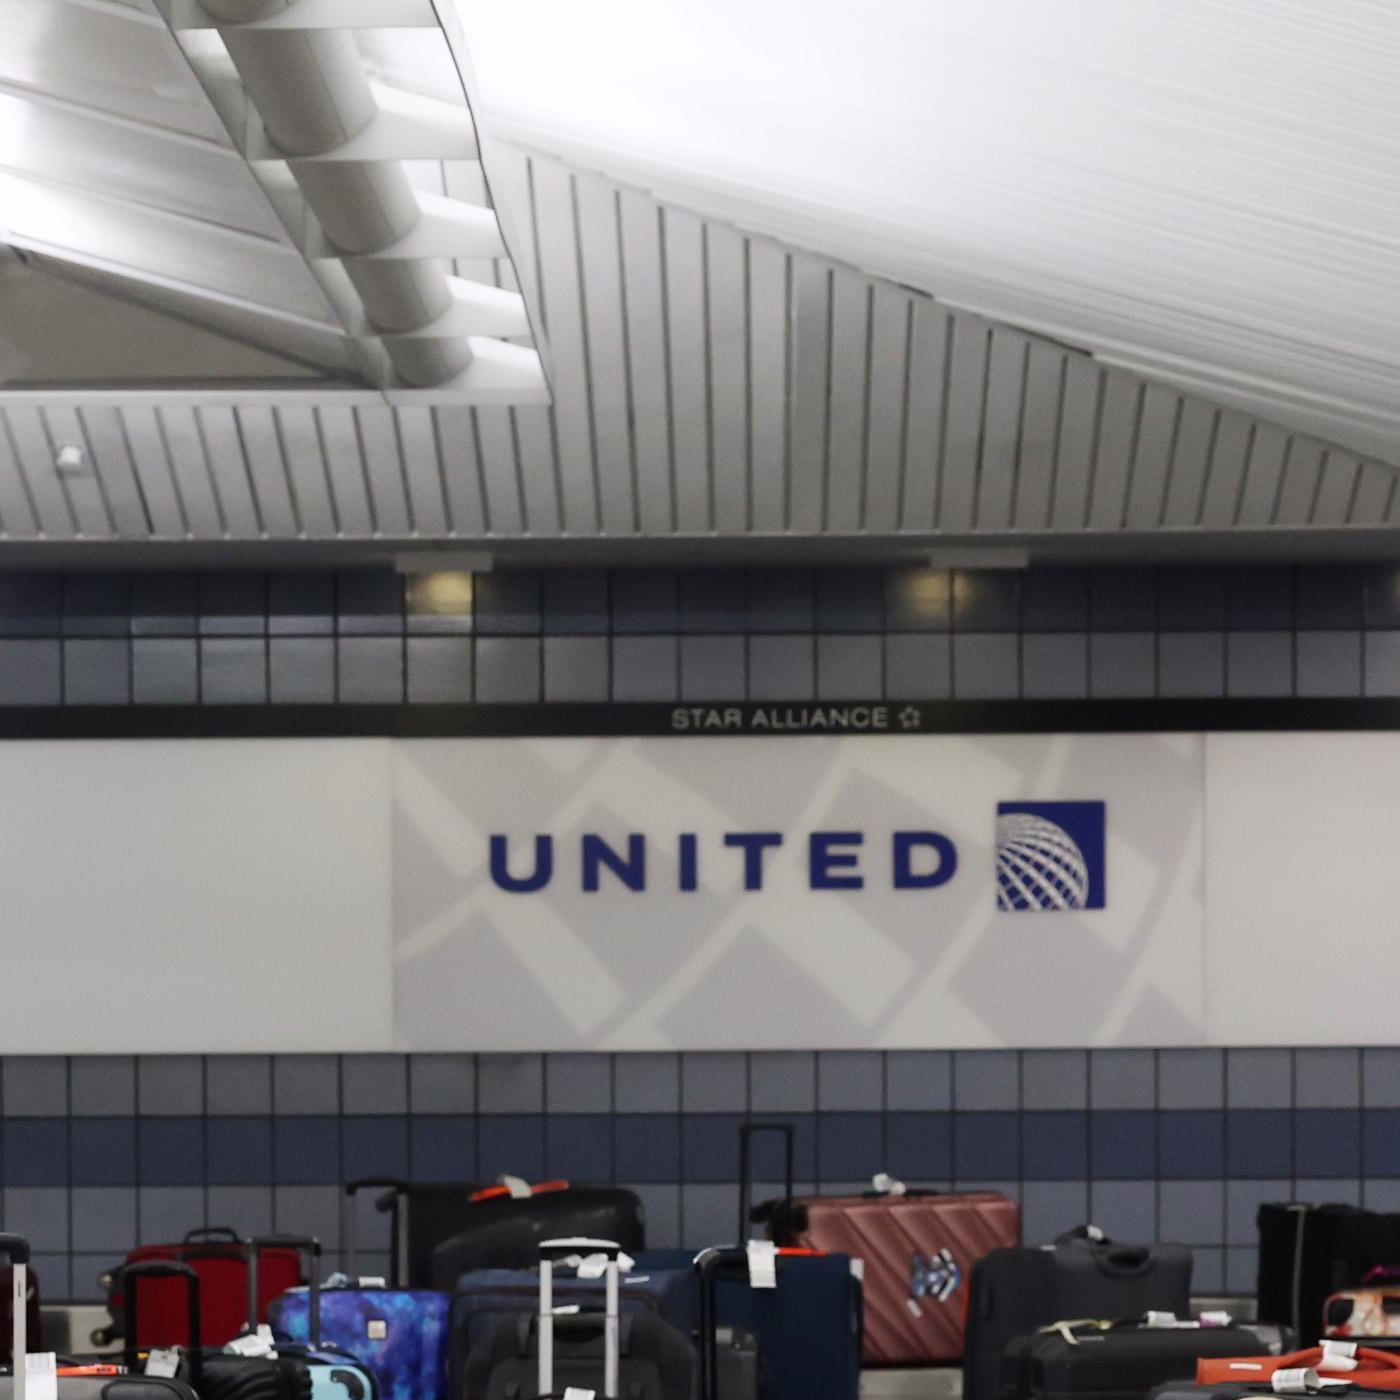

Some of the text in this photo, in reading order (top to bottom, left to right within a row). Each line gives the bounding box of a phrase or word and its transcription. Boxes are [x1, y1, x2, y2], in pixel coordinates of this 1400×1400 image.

[671, 706, 887, 730] STAR ALLIANCE
[489, 831, 957, 893] UNITED
